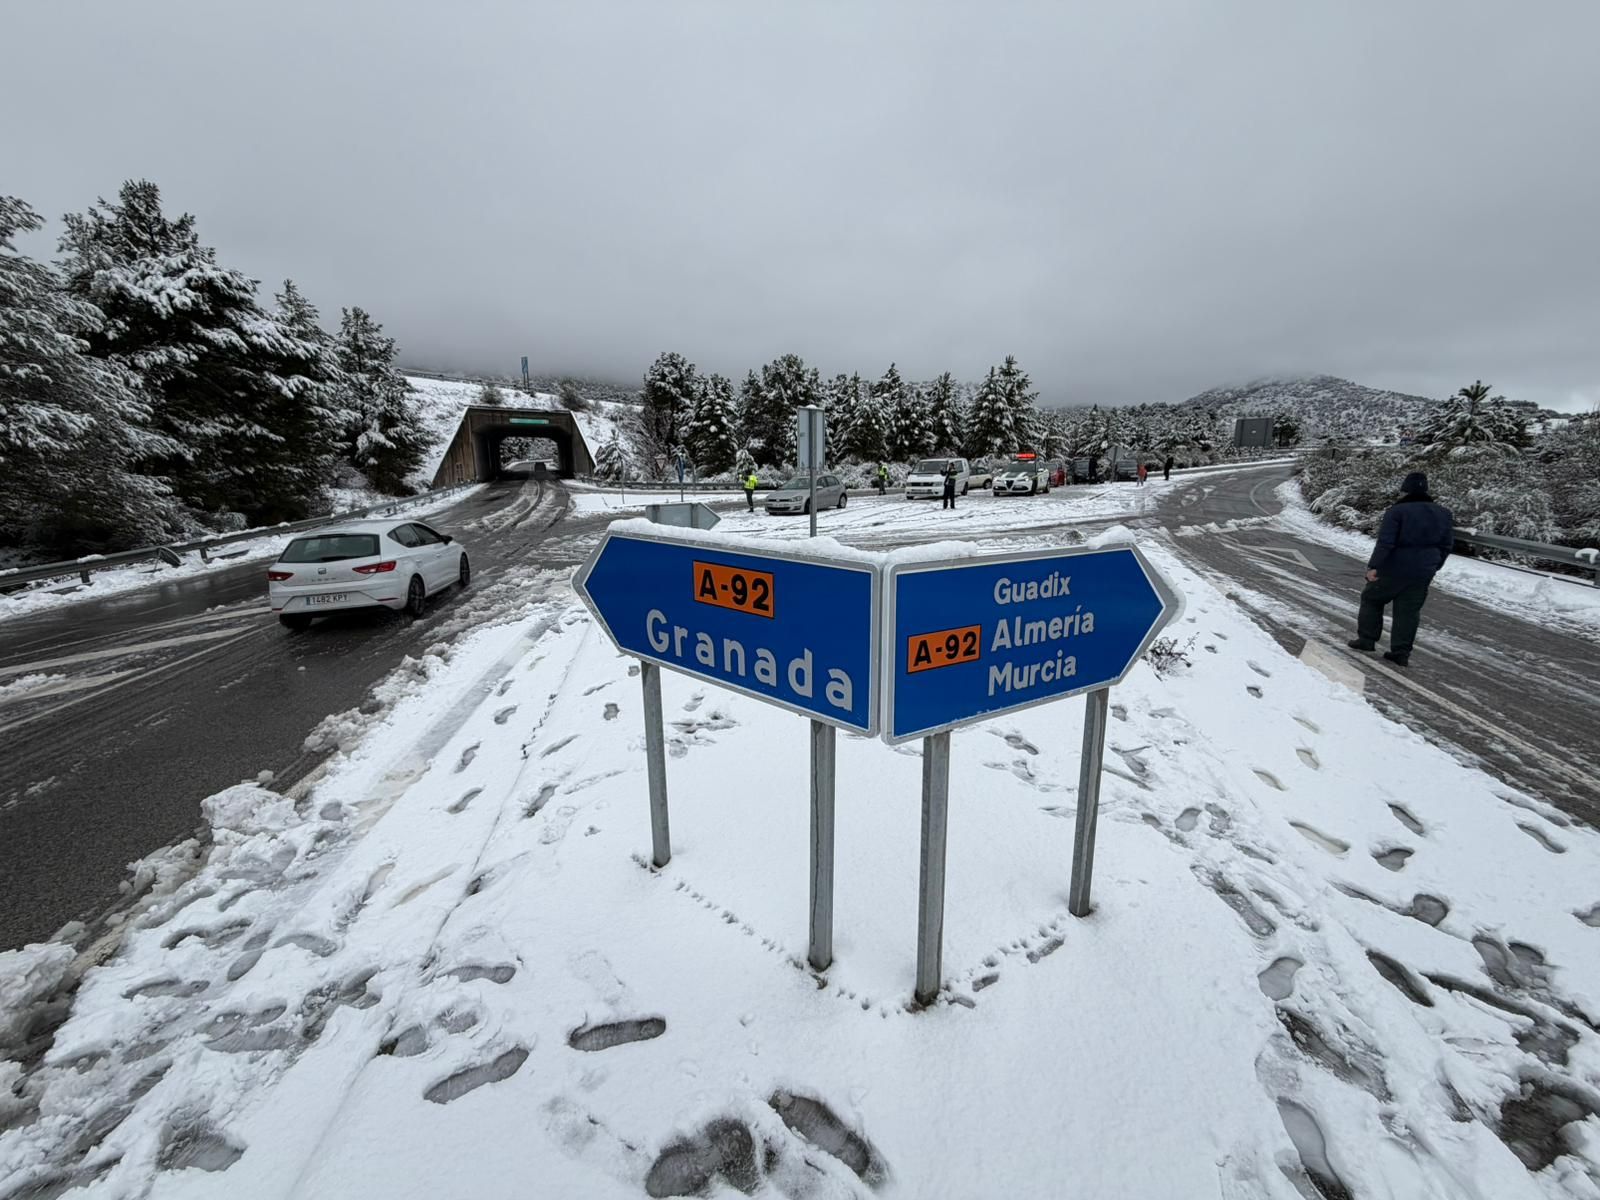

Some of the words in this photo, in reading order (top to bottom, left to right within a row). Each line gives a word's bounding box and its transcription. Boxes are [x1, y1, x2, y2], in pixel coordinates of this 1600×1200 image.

[699, 569, 770, 611] A-92
[994, 571, 1071, 604] Guadix
[913, 631, 977, 667] A-92
[991, 605, 1095, 652] Almería
[646, 608, 853, 712] Granada
[988, 650, 1077, 696] Murcia
